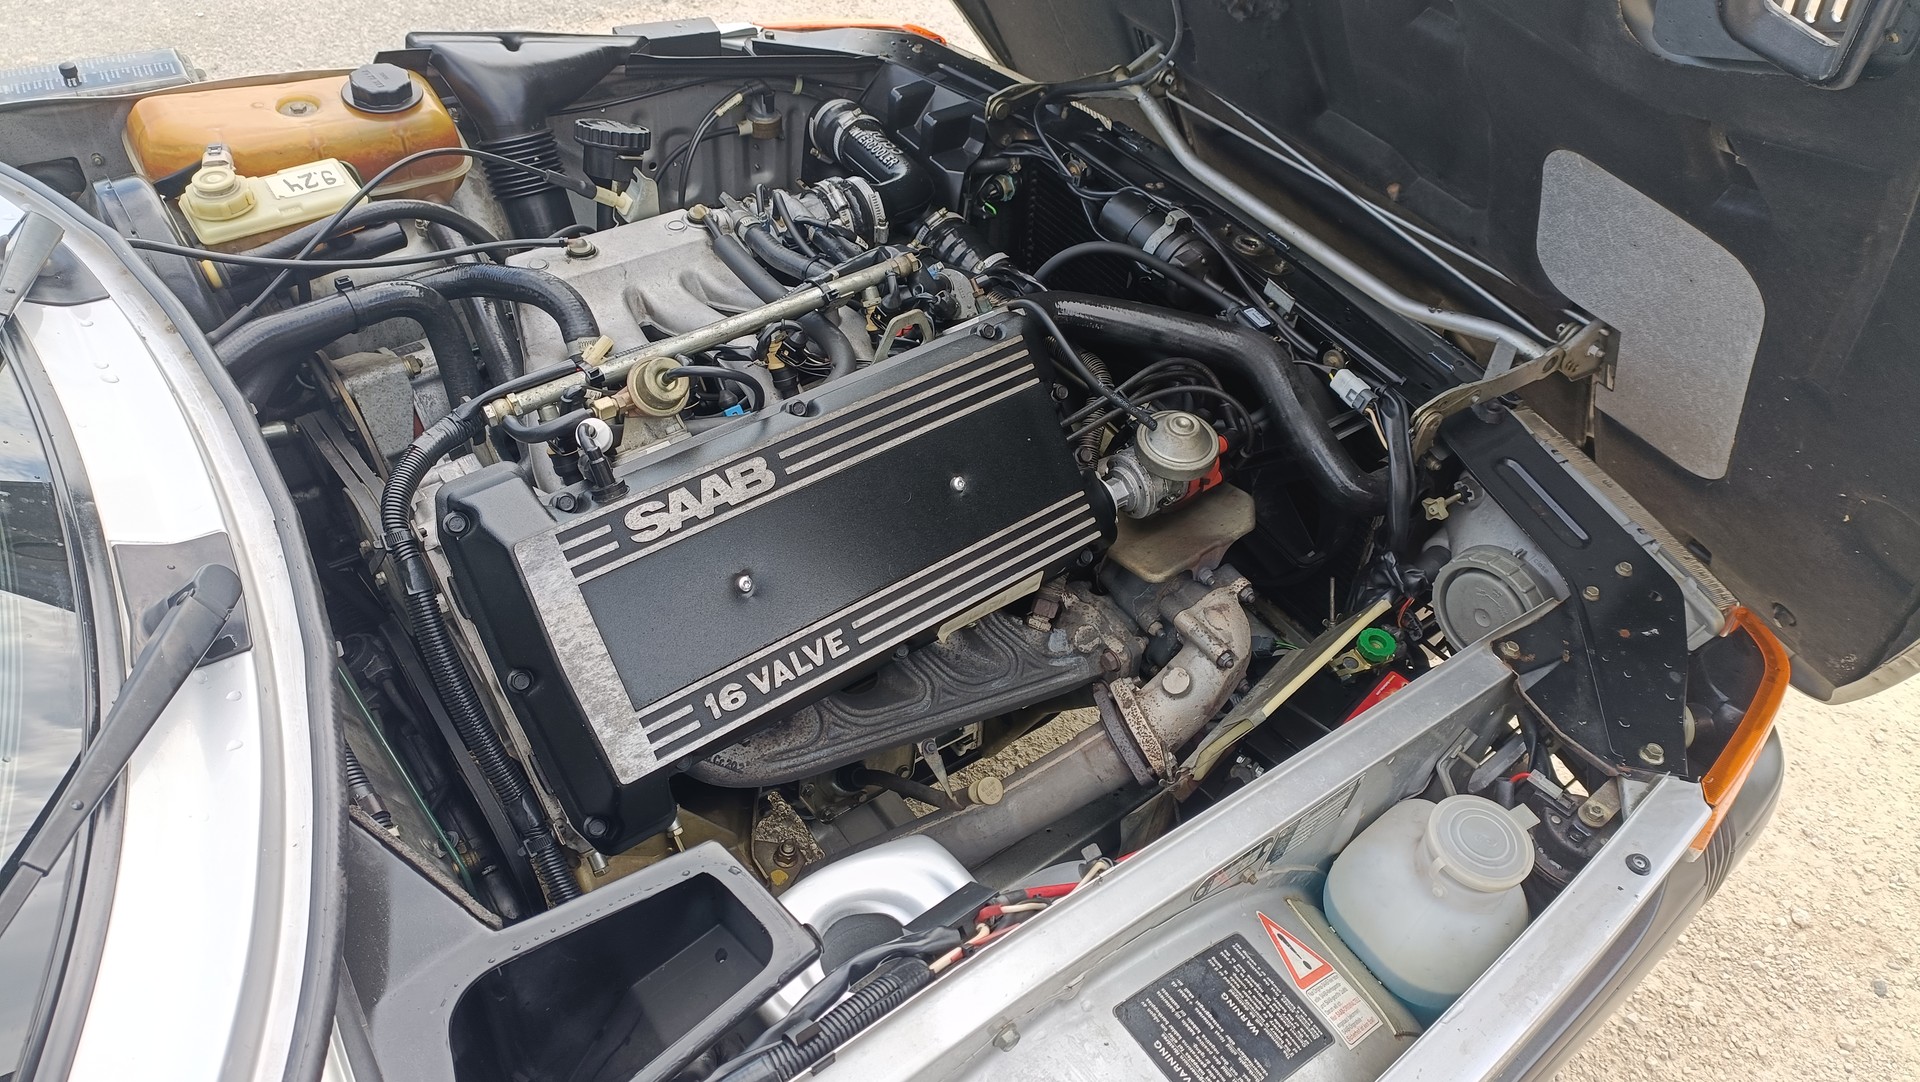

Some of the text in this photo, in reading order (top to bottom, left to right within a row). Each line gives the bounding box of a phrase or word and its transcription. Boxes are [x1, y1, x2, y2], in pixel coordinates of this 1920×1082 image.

[282, 170, 337, 193] 9.24
[848, 126, 900, 170] INTERCOOLER
[623, 455, 777, 545] SAAB
[703, 628, 850, 721] 16 VALVE
